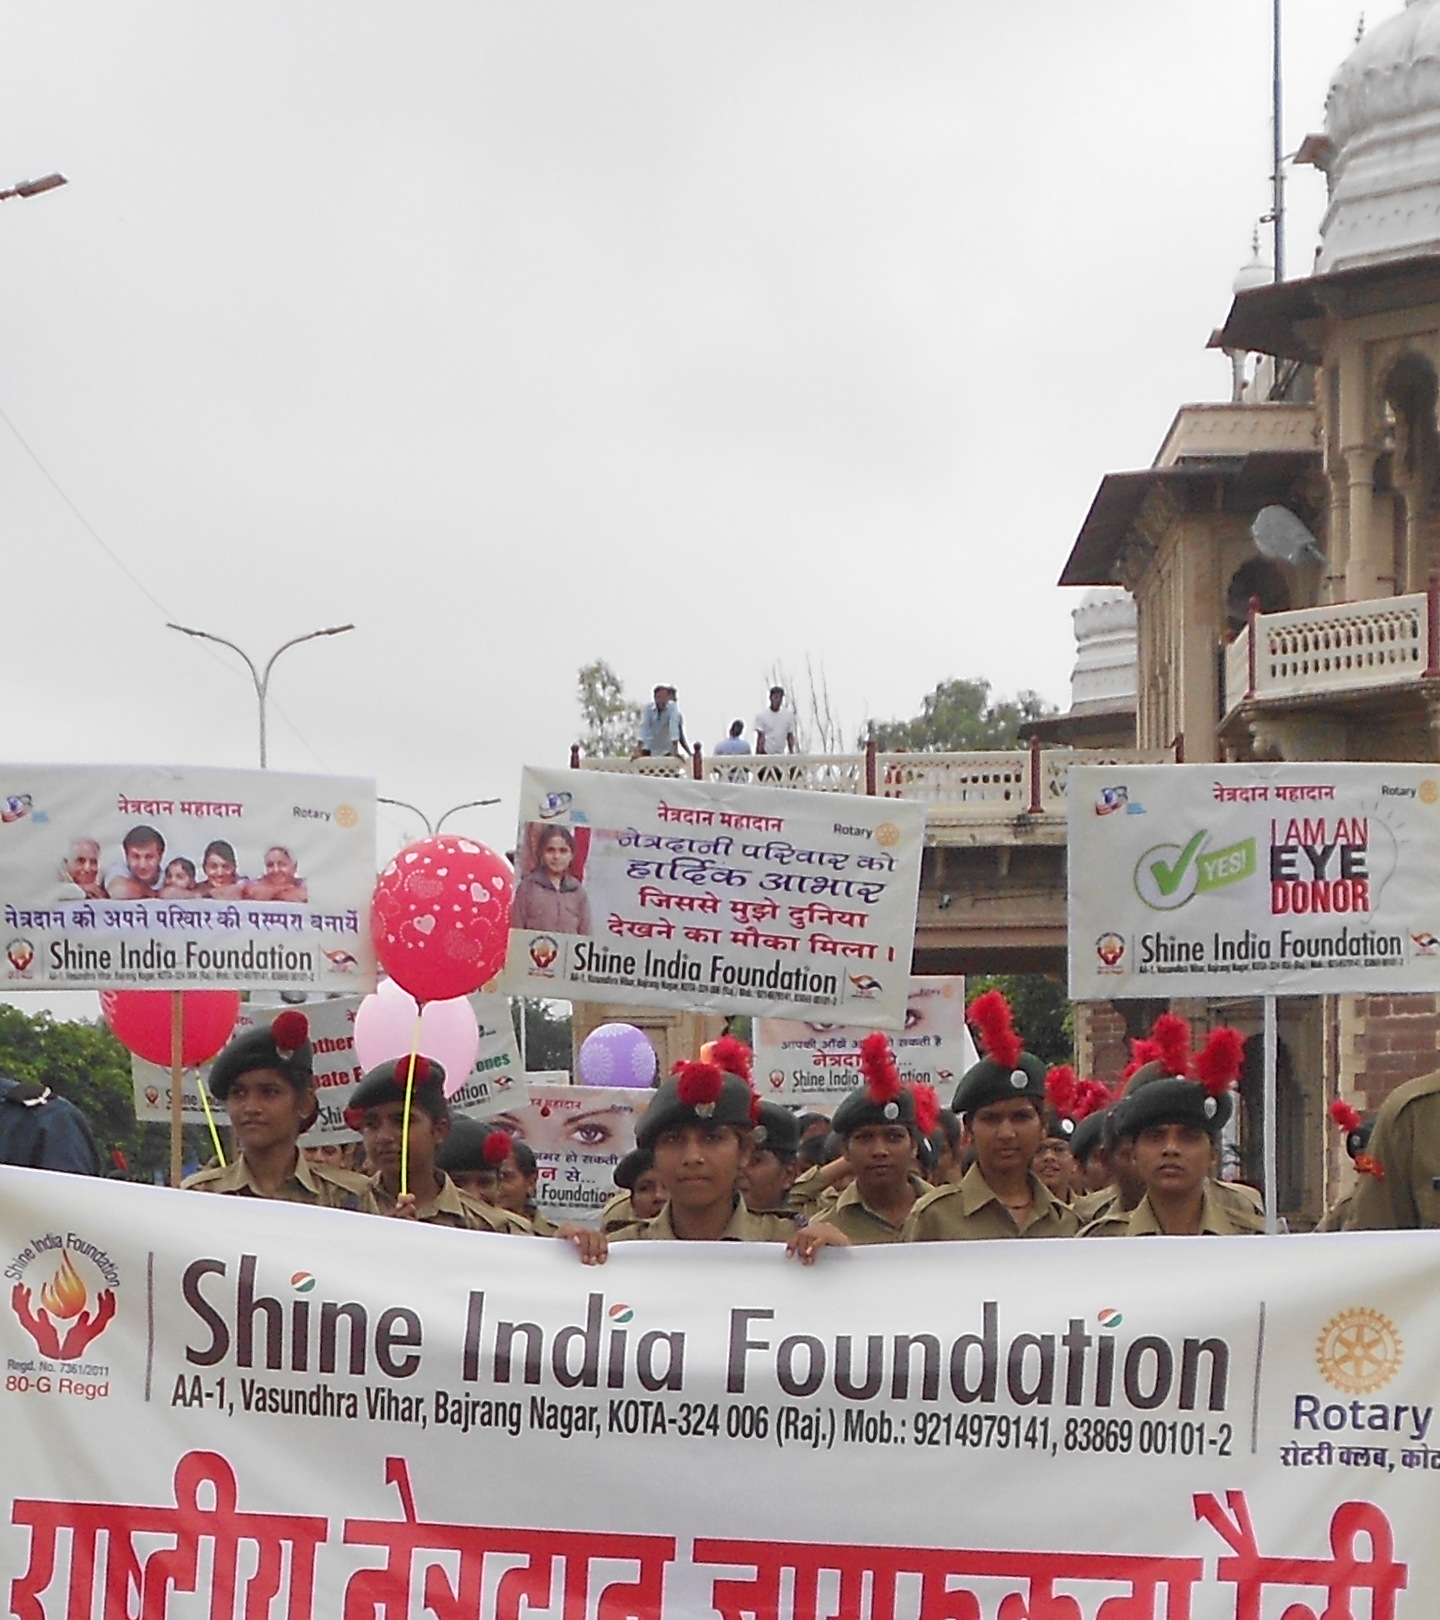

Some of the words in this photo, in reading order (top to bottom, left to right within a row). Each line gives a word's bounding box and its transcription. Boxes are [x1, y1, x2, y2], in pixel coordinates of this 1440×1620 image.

[118, 793, 174, 816] नेत्रदान
[179, 799, 244, 818] महादान
[1213, 782, 1269, 802] नेत्रदान
[1275, 785, 1336, 803] महादान
[1381, 786, 1417, 799] Rotary
[292, 806, 332, 821] Rotary
[657, 800, 715, 826] नेत्रदान
[720, 811, 785, 833] महादान
[833, 823, 874, 839] Rotary
[1271, 818, 1277, 845] I
[1285, 817, 1326, 846] AM
[1333, 817, 1369, 846] AN
[618, 827, 734, 857] नेत्रदानी
[742, 841, 850, 871] परिवार
[857, 852, 899, 873] को
[1204, 851, 1247, 881] YES!
[1270, 845, 1369, 882] EYE
[626, 856, 753, 887] हार्दिक
[759, 872, 889, 904] आभार
[639, 886, 722, 914] जिससे
[730, 897, 781, 924] मुझे
[788, 902, 869, 929] दुनिया
[1272, 879, 1370, 915] DONOR
[5, 904, 66, 929] नेत्रदान
[72, 904, 96, 928] को
[103, 904, 149, 929] अपने
[156, 904, 213, 930] परिवार
[216, 905, 242, 930] की
[608, 913, 676, 940] देखने
[683, 926, 723, 946] का
[730, 925, 801, 953] मौका
[809, 932, 878, 960] मिला
[1142, 933, 1205, 963] Shine
[1214, 929, 1271, 961] India
[1279, 926, 1402, 959] Foundation
[49, 938, 111, 970] Shine
[120, 941, 178, 969] India
[186, 940, 312, 971] Foundation
[574, 942, 636, 975] Shine
[644, 949, 701, 982] India
[710, 955, 837, 994] Foundation
[812, 1049, 861, 1068] नेत्रदा
[792, 1069, 825, 1087] Shine
[829, 1069, 859, 1086] India
[319, 1106, 343, 1125] Shi
[4, 1248, 36, 1280] Shine
[31, 1233, 63, 1250] India
[66, 1232, 120, 1288] Foundation
[181, 1254, 424, 1378] Shine
[462, 1290, 687, 1393] India
[725, 1300, 1231, 1412] Foundation
[6, 1375, 51, 1393] 80-G
[58, 1378, 109, 1400] Regd
[172, 1374, 234, 1417] AA-1,
[240, 1378, 359, 1419] Vasundhra
[364, 1386, 428, 1429] Vihar,
[434, 1391, 522, 1434] Bajrang
[529, 1397, 602, 1438] Nagar,
[608, 1400, 720, 1438] KOTA-324
[726, 1407, 770, 1440] 006
[775, 1406, 837, 1448] (Raj.)
[843, 1408, 907, 1446] Mob.:
[913, 1411, 1058, 1456] 9214979141,
[1063, 1416, 1134, 1453] 83869
[1138, 1420, 1233, 1456] 00101-2
[1294, 1394, 1433, 1440] Rotary
[1280, 1441, 1333, 1467] रोटरी
